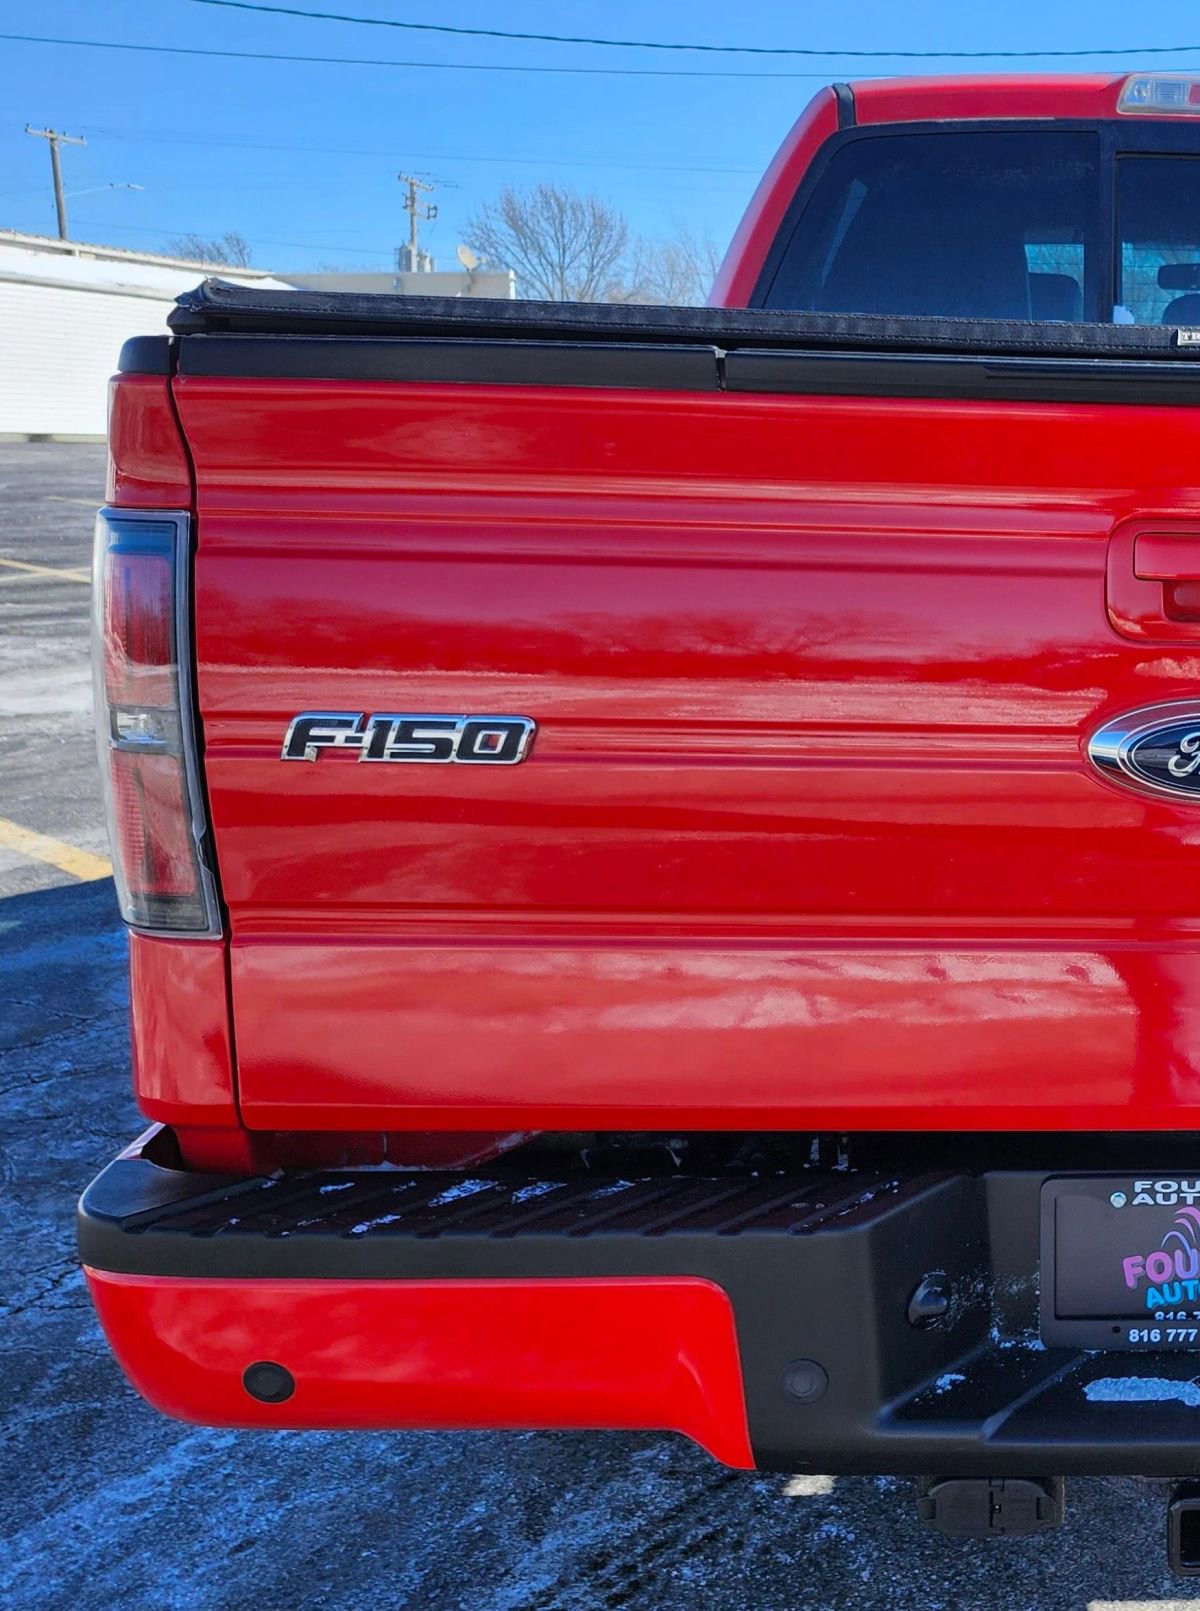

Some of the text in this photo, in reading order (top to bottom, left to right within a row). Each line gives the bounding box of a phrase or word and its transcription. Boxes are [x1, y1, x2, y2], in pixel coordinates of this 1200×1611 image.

[280, 711, 537, 765] F-150
[1128, 1328, 1161, 1343] 816
[1166, 1328, 1199, 1343] 777
